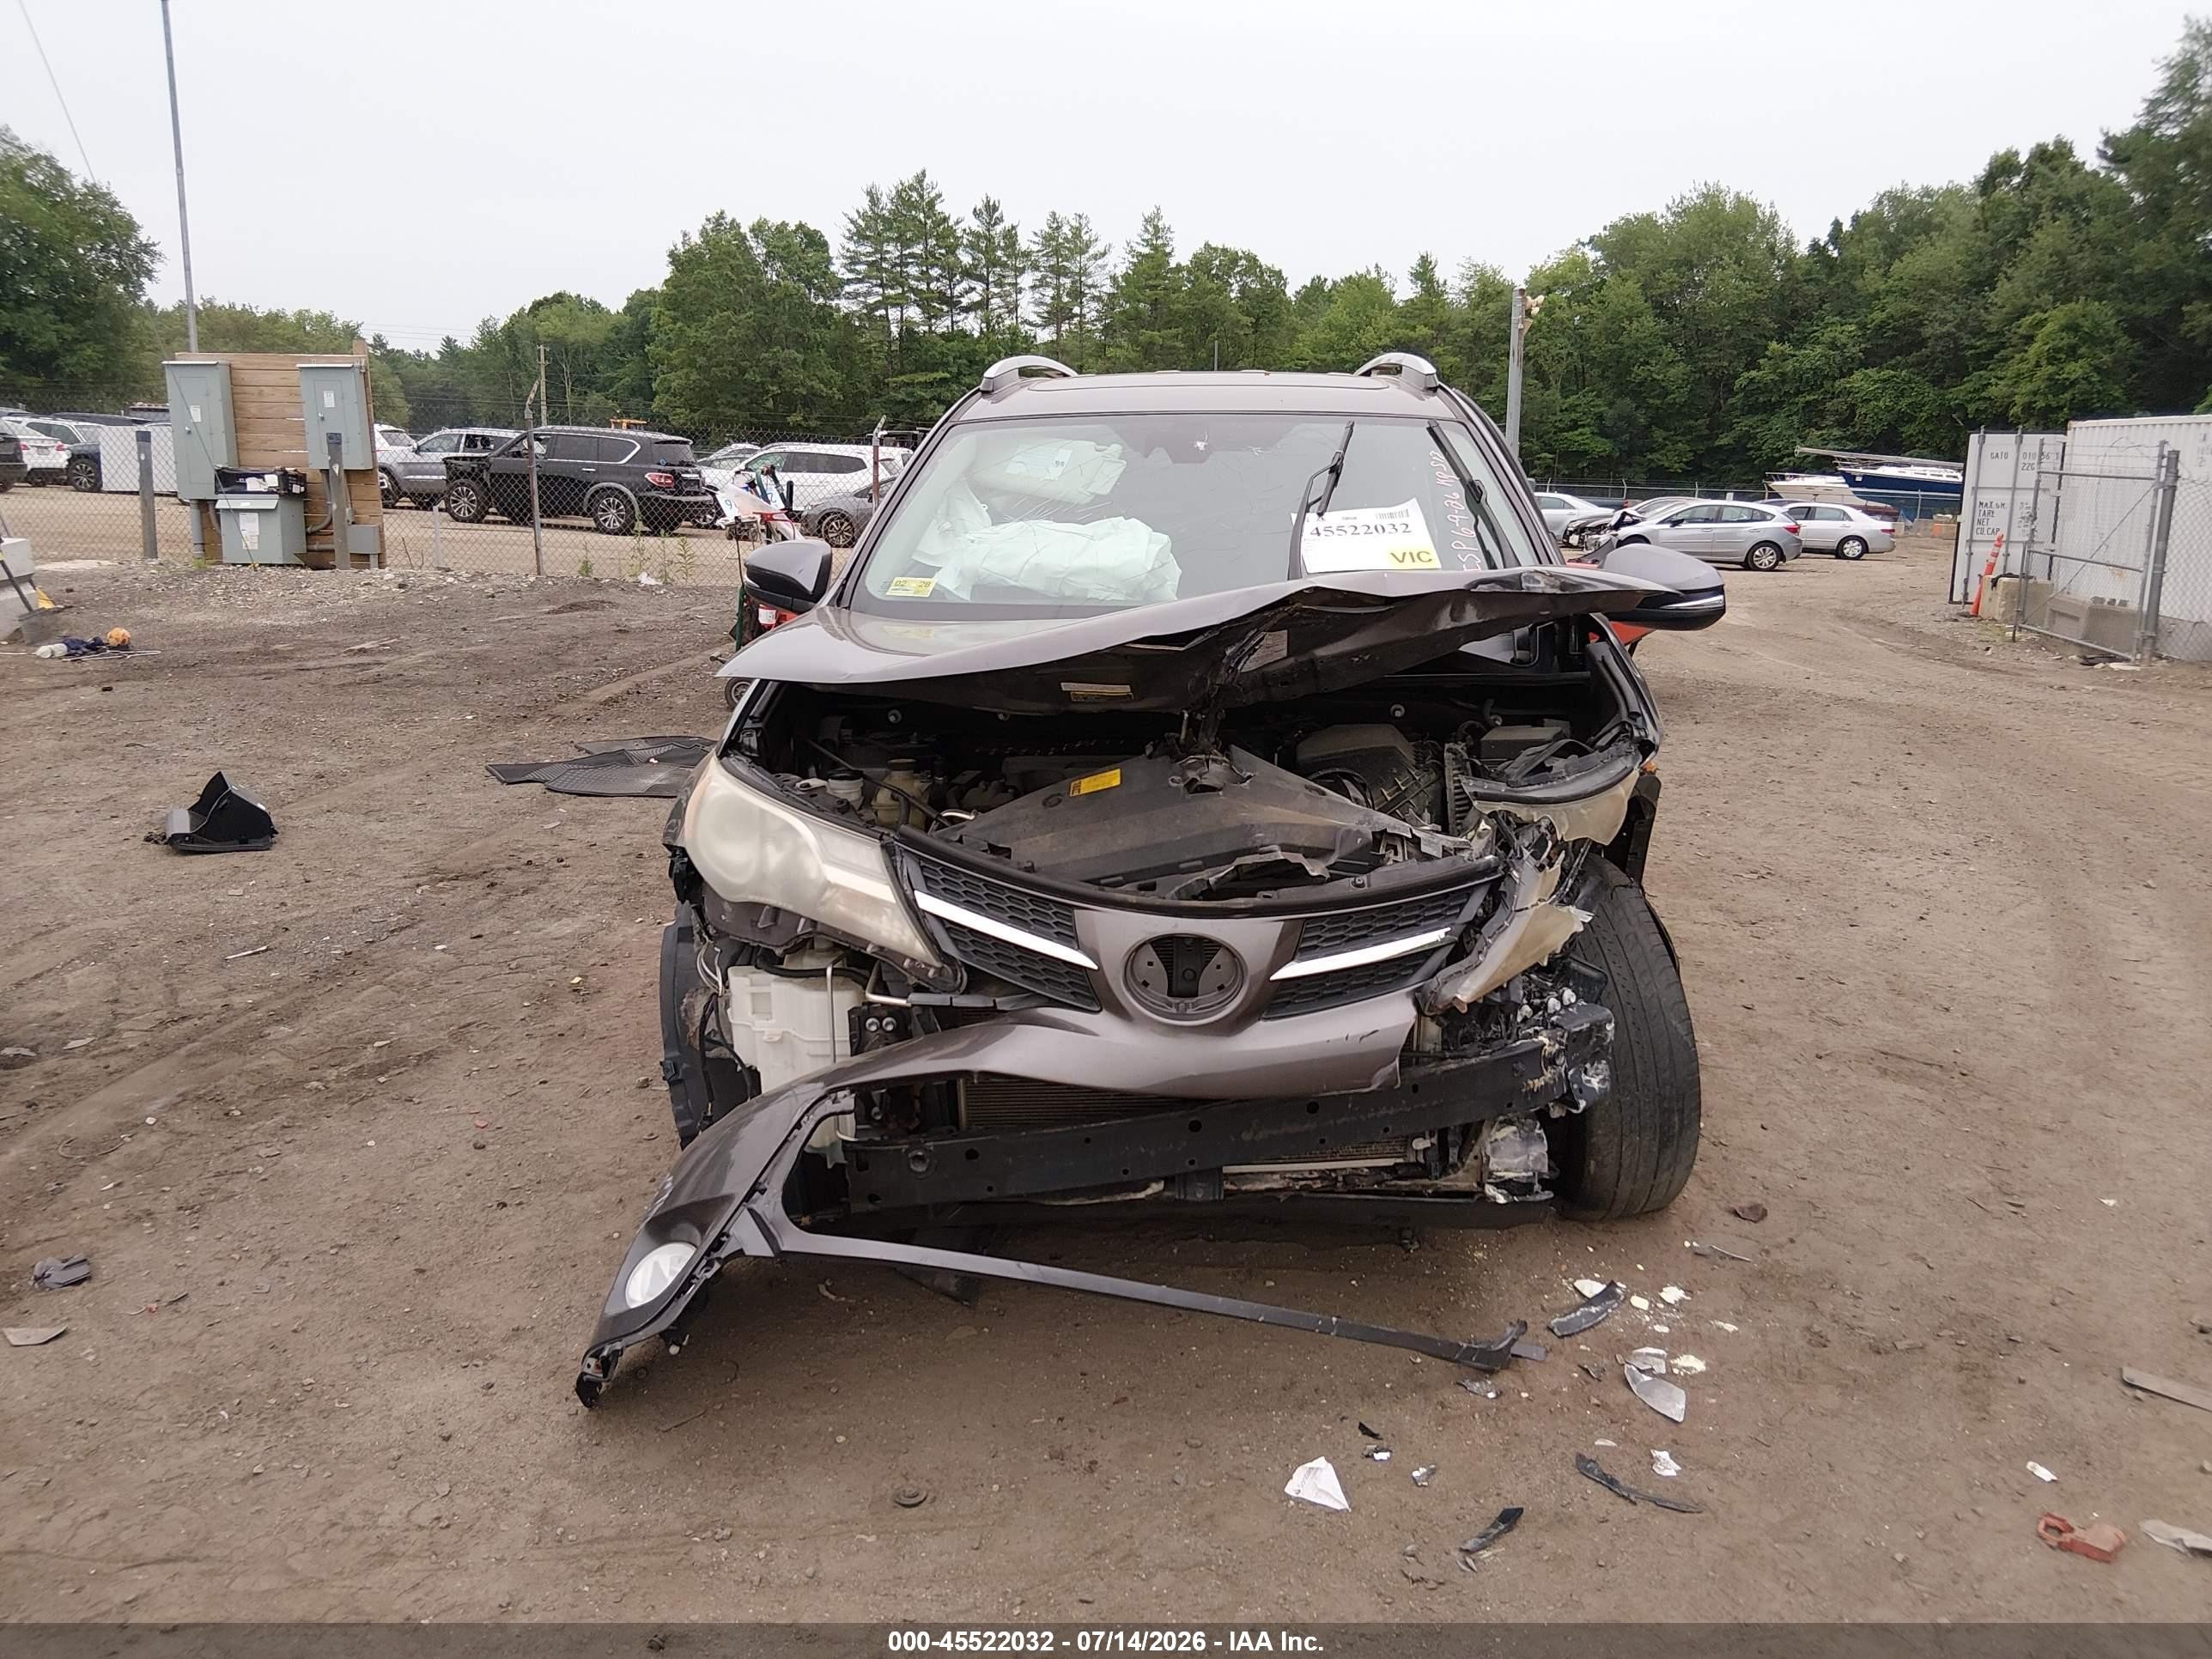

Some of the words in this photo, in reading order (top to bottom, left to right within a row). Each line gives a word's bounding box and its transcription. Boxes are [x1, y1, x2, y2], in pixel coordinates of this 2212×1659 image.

[1976, 518, 1990, 526] NET
[1310, 523, 1412, 537] 45522032
[1390, 550, 1433, 563] VIC
